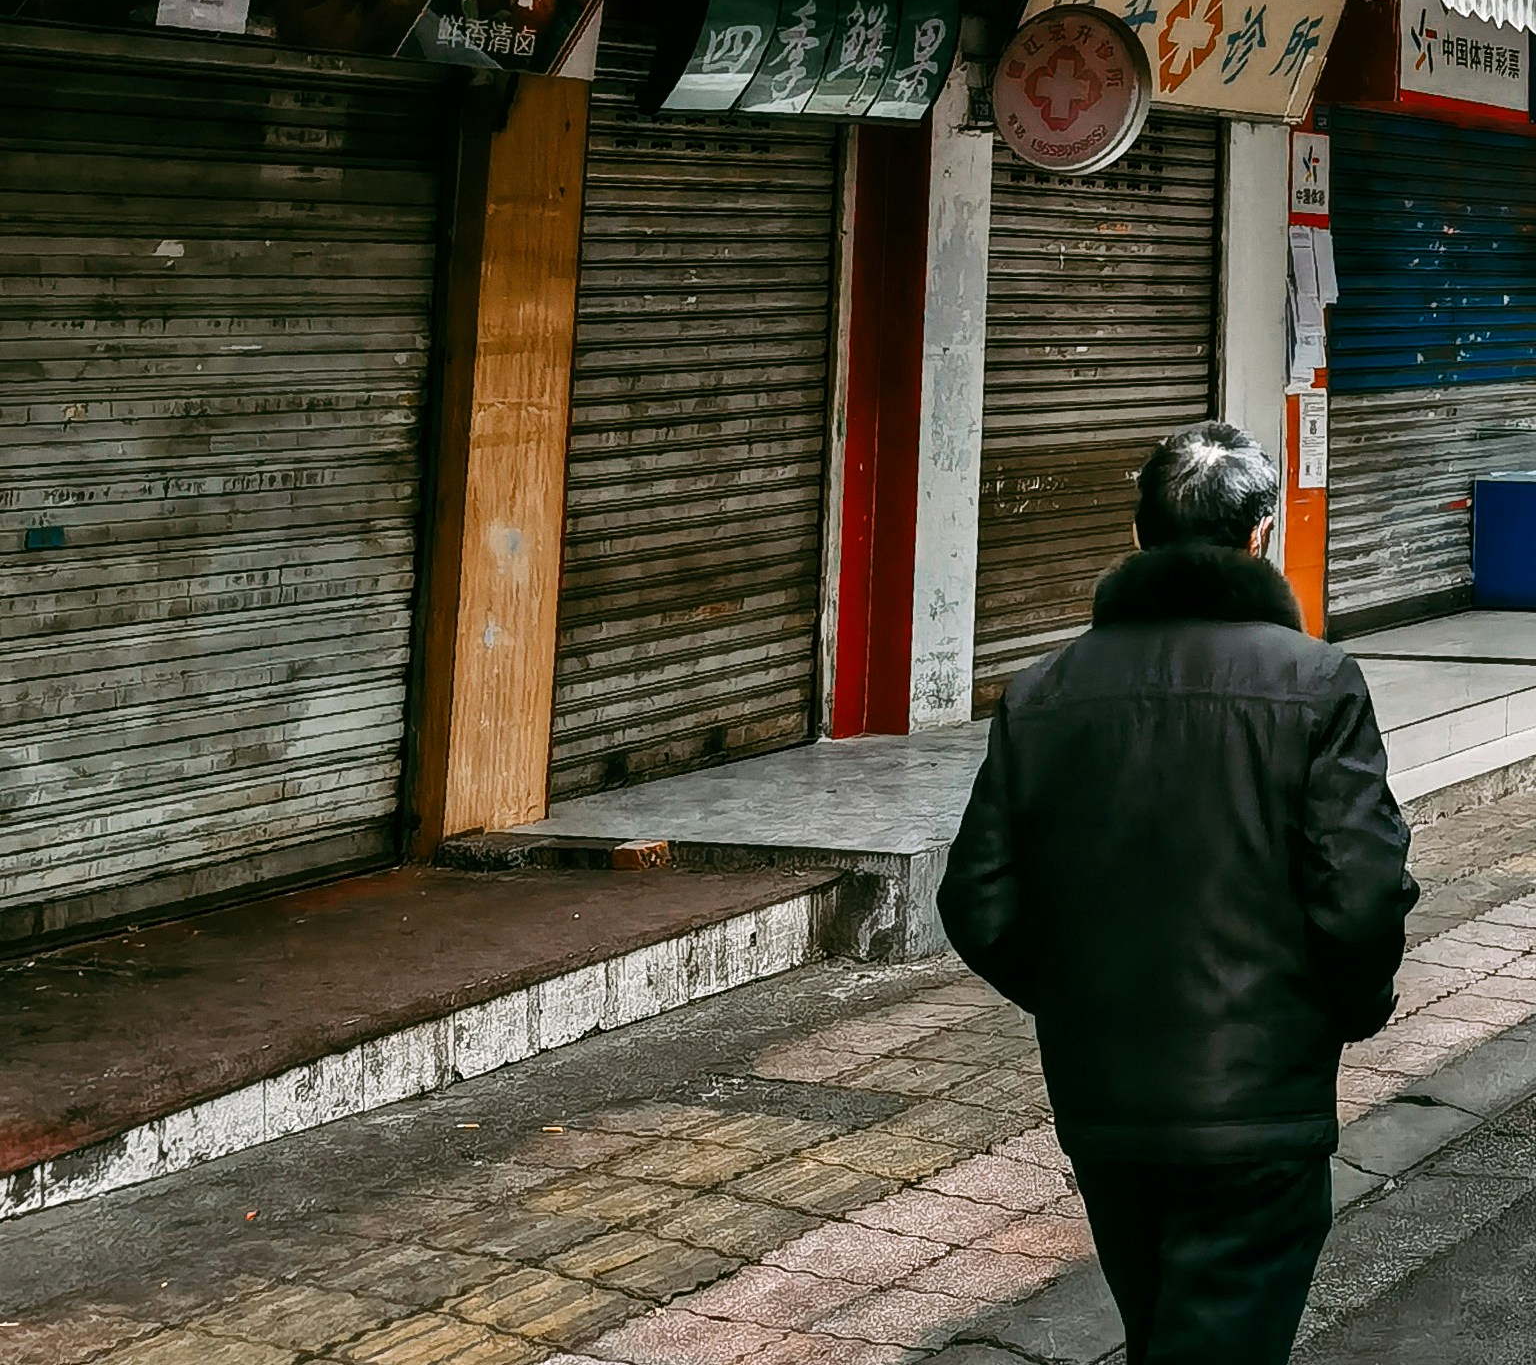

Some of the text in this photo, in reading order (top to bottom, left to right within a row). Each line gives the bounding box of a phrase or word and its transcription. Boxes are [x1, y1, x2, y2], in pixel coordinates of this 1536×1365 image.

[1220, 5, 1326, 85] 诊所
[1441, 31, 1521, 79] 中国体育彩票
